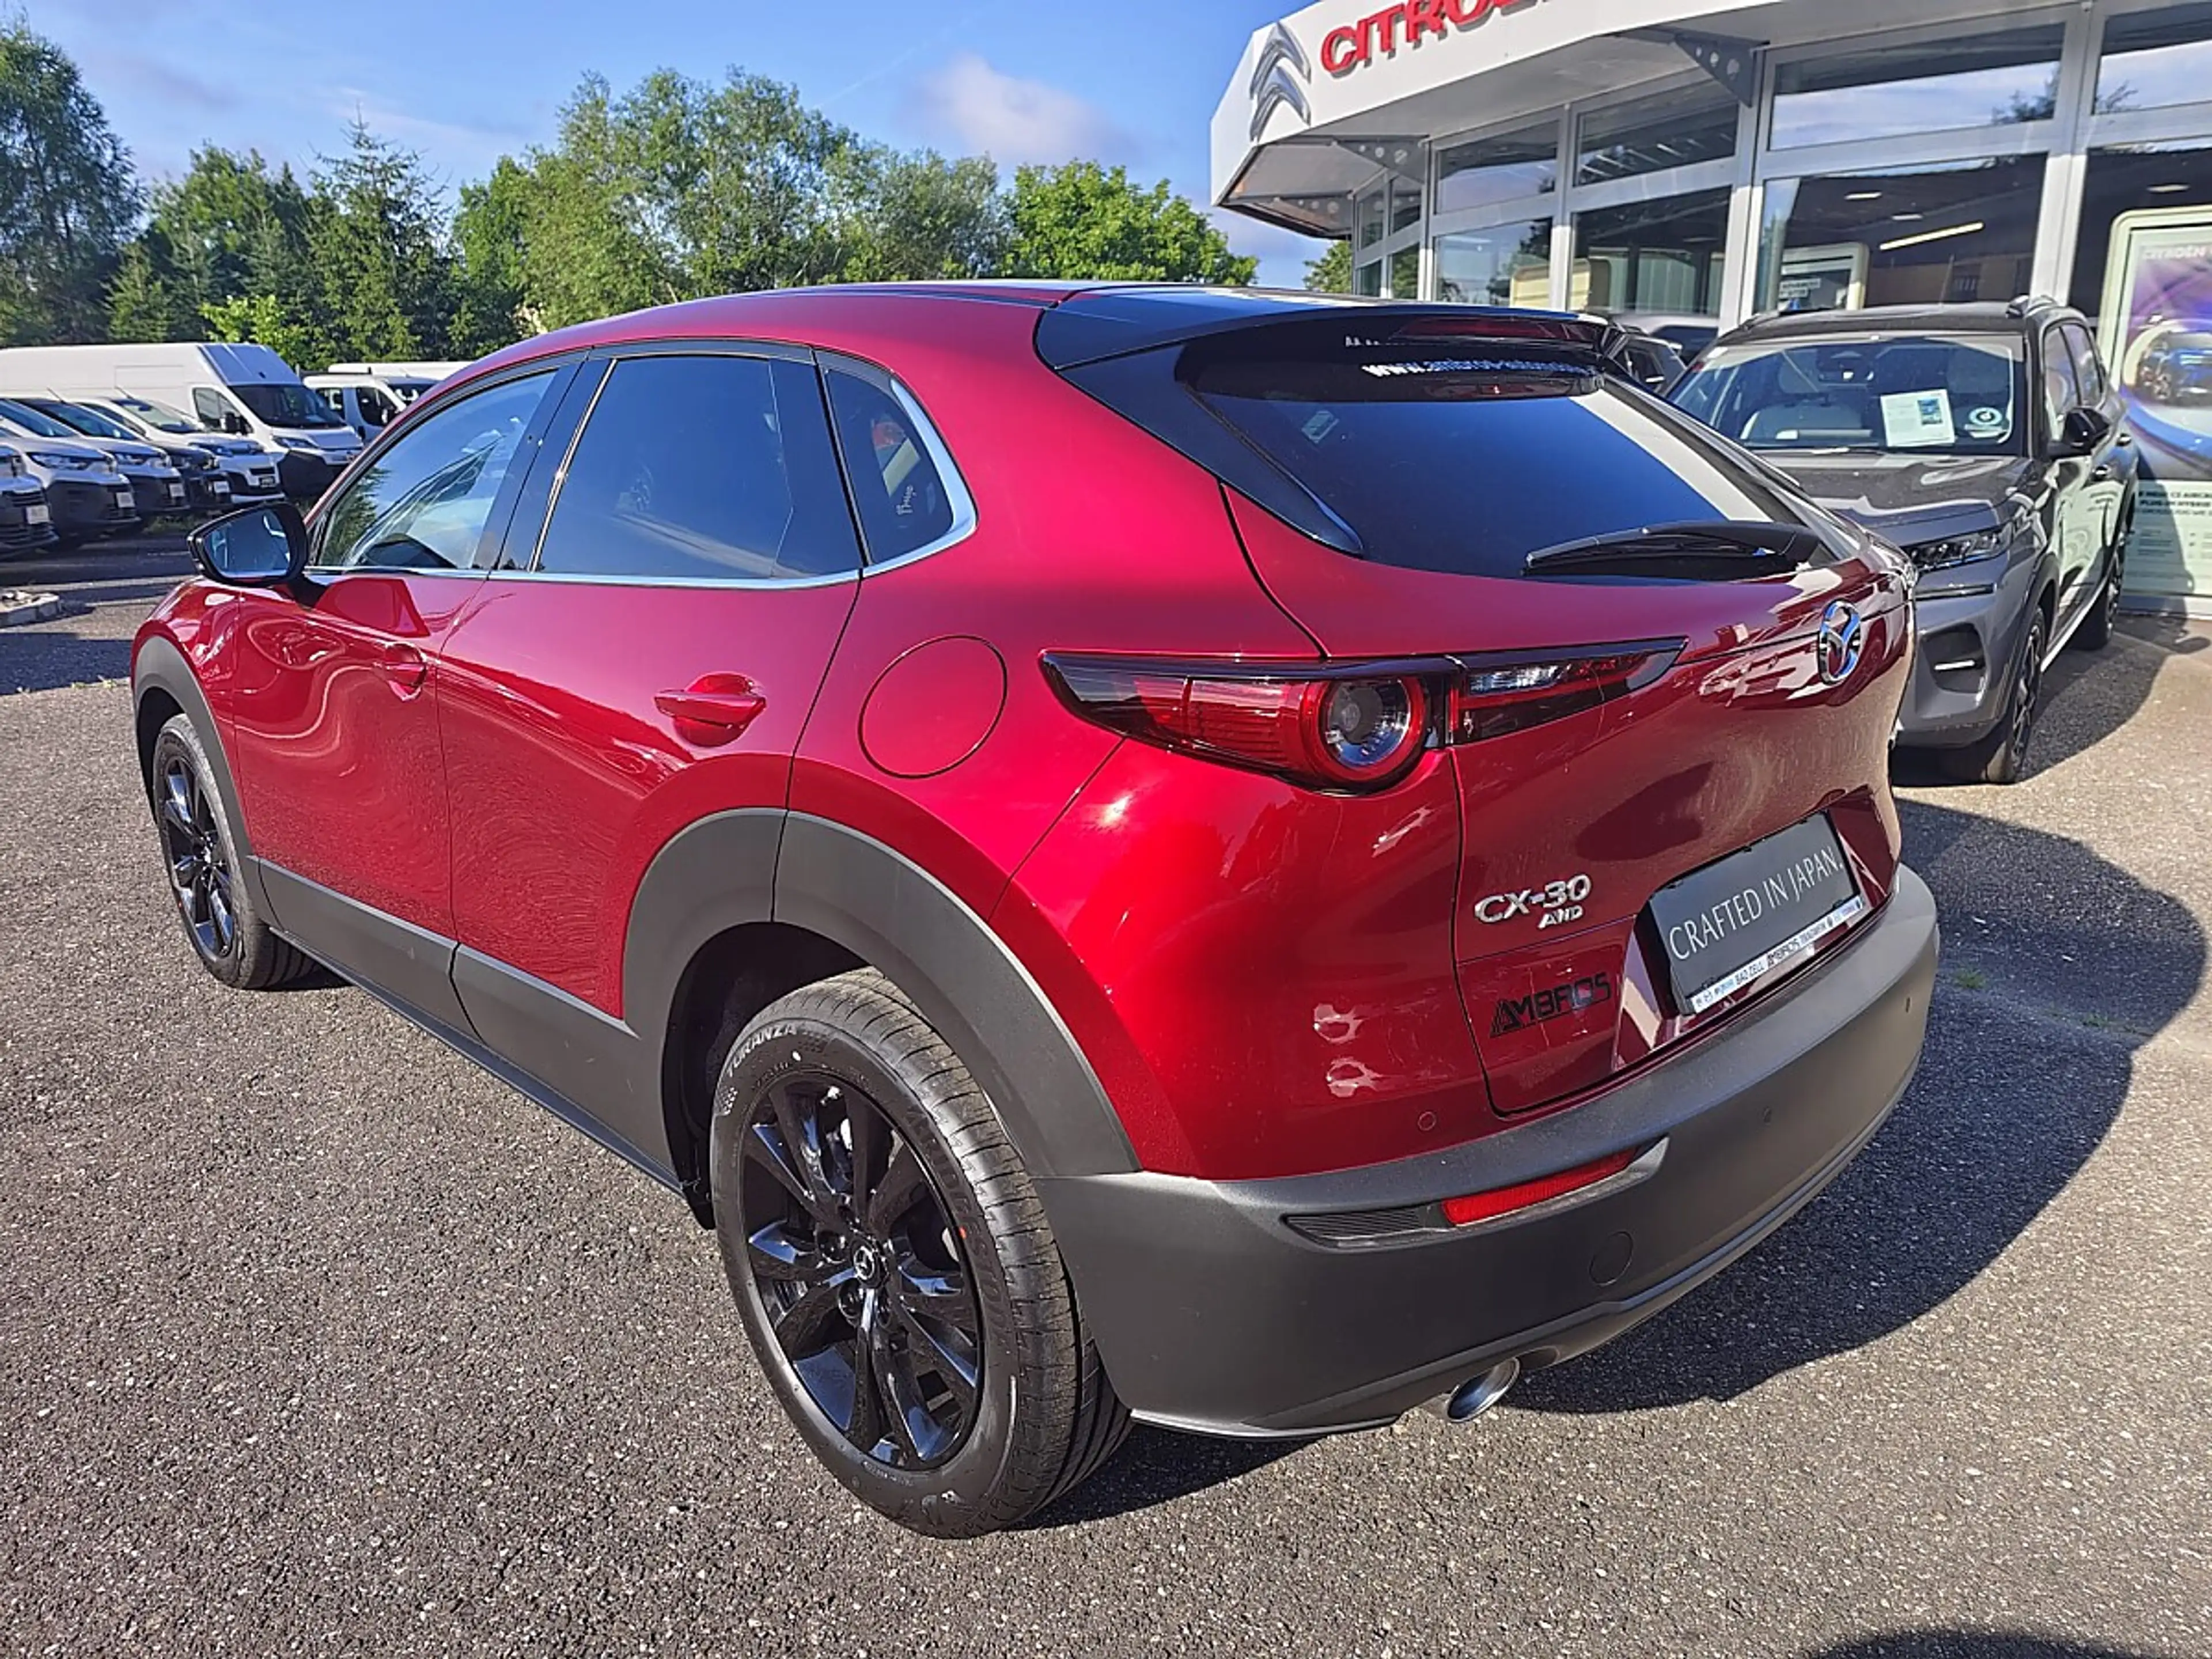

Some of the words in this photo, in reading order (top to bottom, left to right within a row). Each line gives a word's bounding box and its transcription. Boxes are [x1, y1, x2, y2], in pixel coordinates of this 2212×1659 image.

[1321, 0, 1527, 74] CITRO
[1474, 873, 1592, 923] CX-30
[1537, 904, 1584, 930] AWD
[1669, 888, 1762, 960] CRAFTED
[1762, 873, 1789, 910] IN
